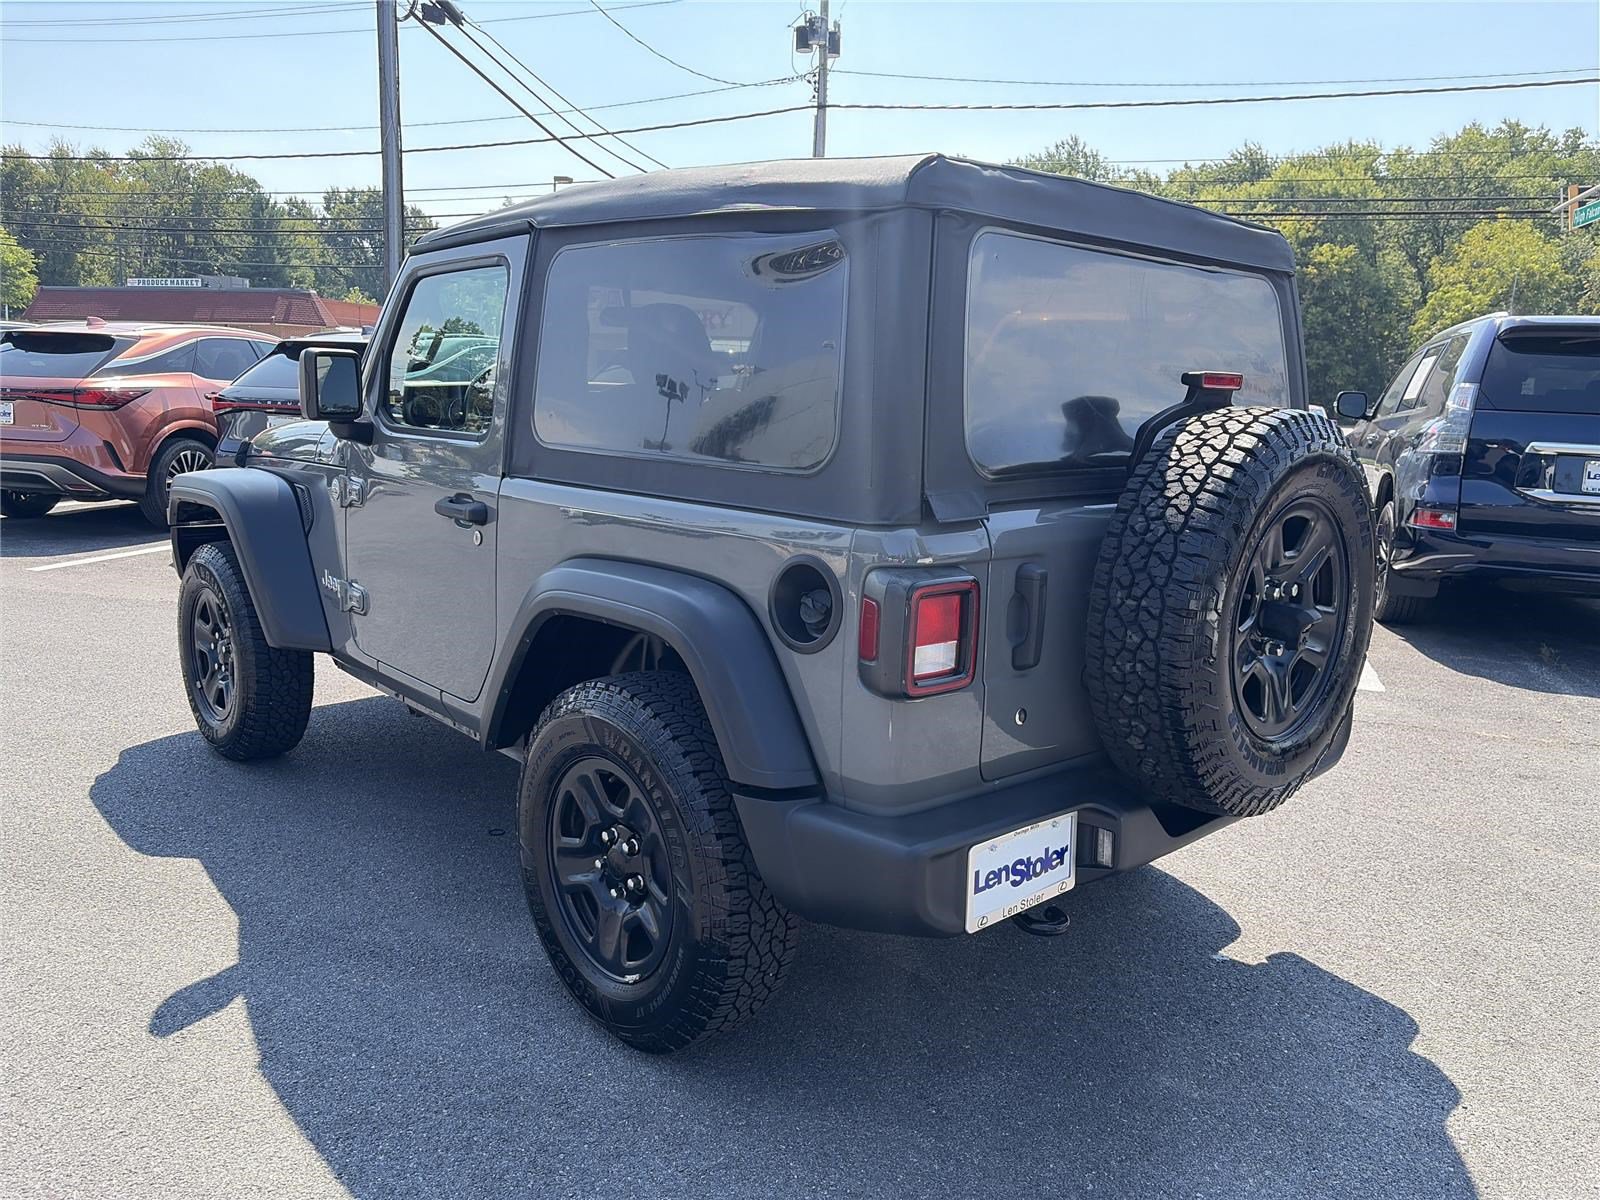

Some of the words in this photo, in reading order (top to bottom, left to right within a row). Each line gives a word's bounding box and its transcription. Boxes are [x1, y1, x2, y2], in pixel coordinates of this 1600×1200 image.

[321, 568, 342, 598] Jeep
[603, 727, 686, 868] WRANGLER
[1002, 903, 1018, 918] Len
[1019, 893, 1045, 910] Stoler
